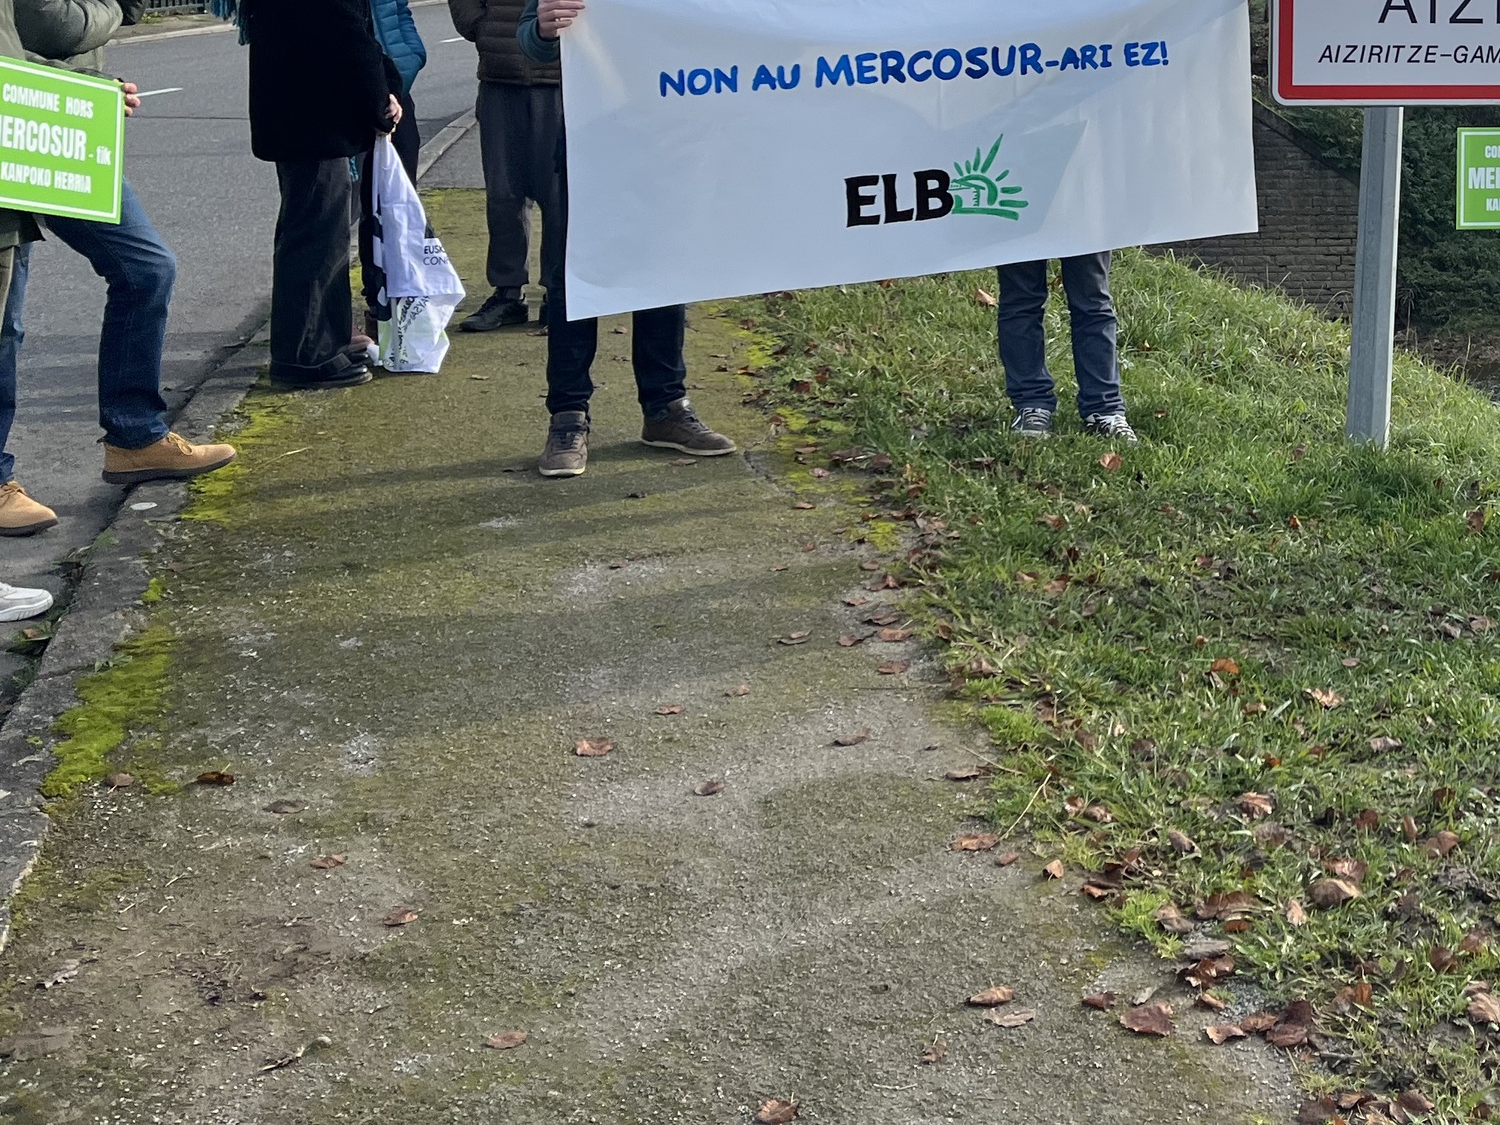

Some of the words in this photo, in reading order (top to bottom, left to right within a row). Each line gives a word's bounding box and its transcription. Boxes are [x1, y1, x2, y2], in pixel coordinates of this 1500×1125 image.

[658, 65, 739, 98] NON
[751, 63, 800, 93] AU
[815, 41, 1112, 89] MERCOSUR-ARI
[1124, 40, 1169, 68] EZ!
[2, 82, 60, 113] COMMUNE
[65, 96, 94, 119] HORS
[0, 161, 51, 188] KANPOKO
[54, 170, 92, 194] HERRIA
[843, 168, 955, 229] ELB
